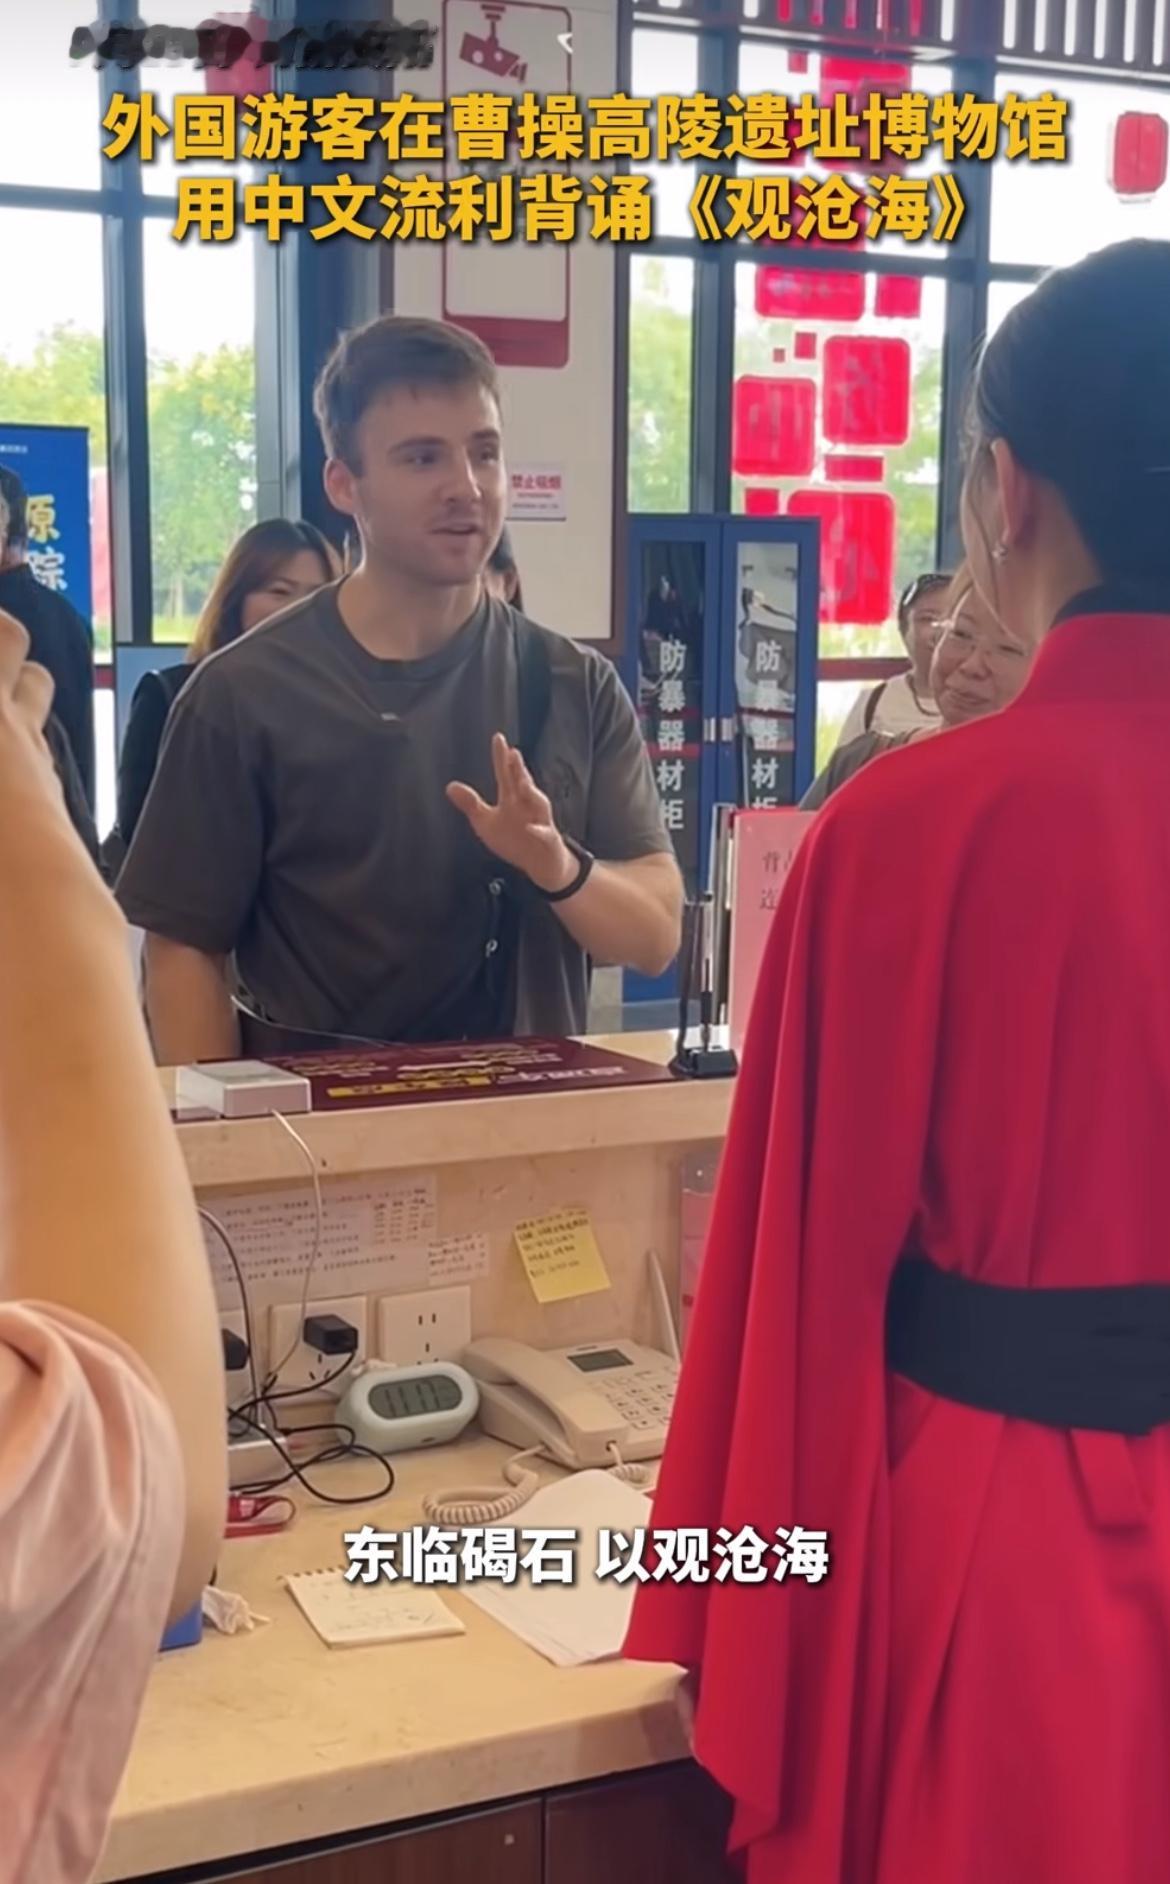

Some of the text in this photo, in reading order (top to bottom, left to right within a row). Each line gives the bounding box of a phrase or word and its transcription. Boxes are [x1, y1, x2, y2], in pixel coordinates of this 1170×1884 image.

[658, 639, 687, 830] 防暴器材柜
